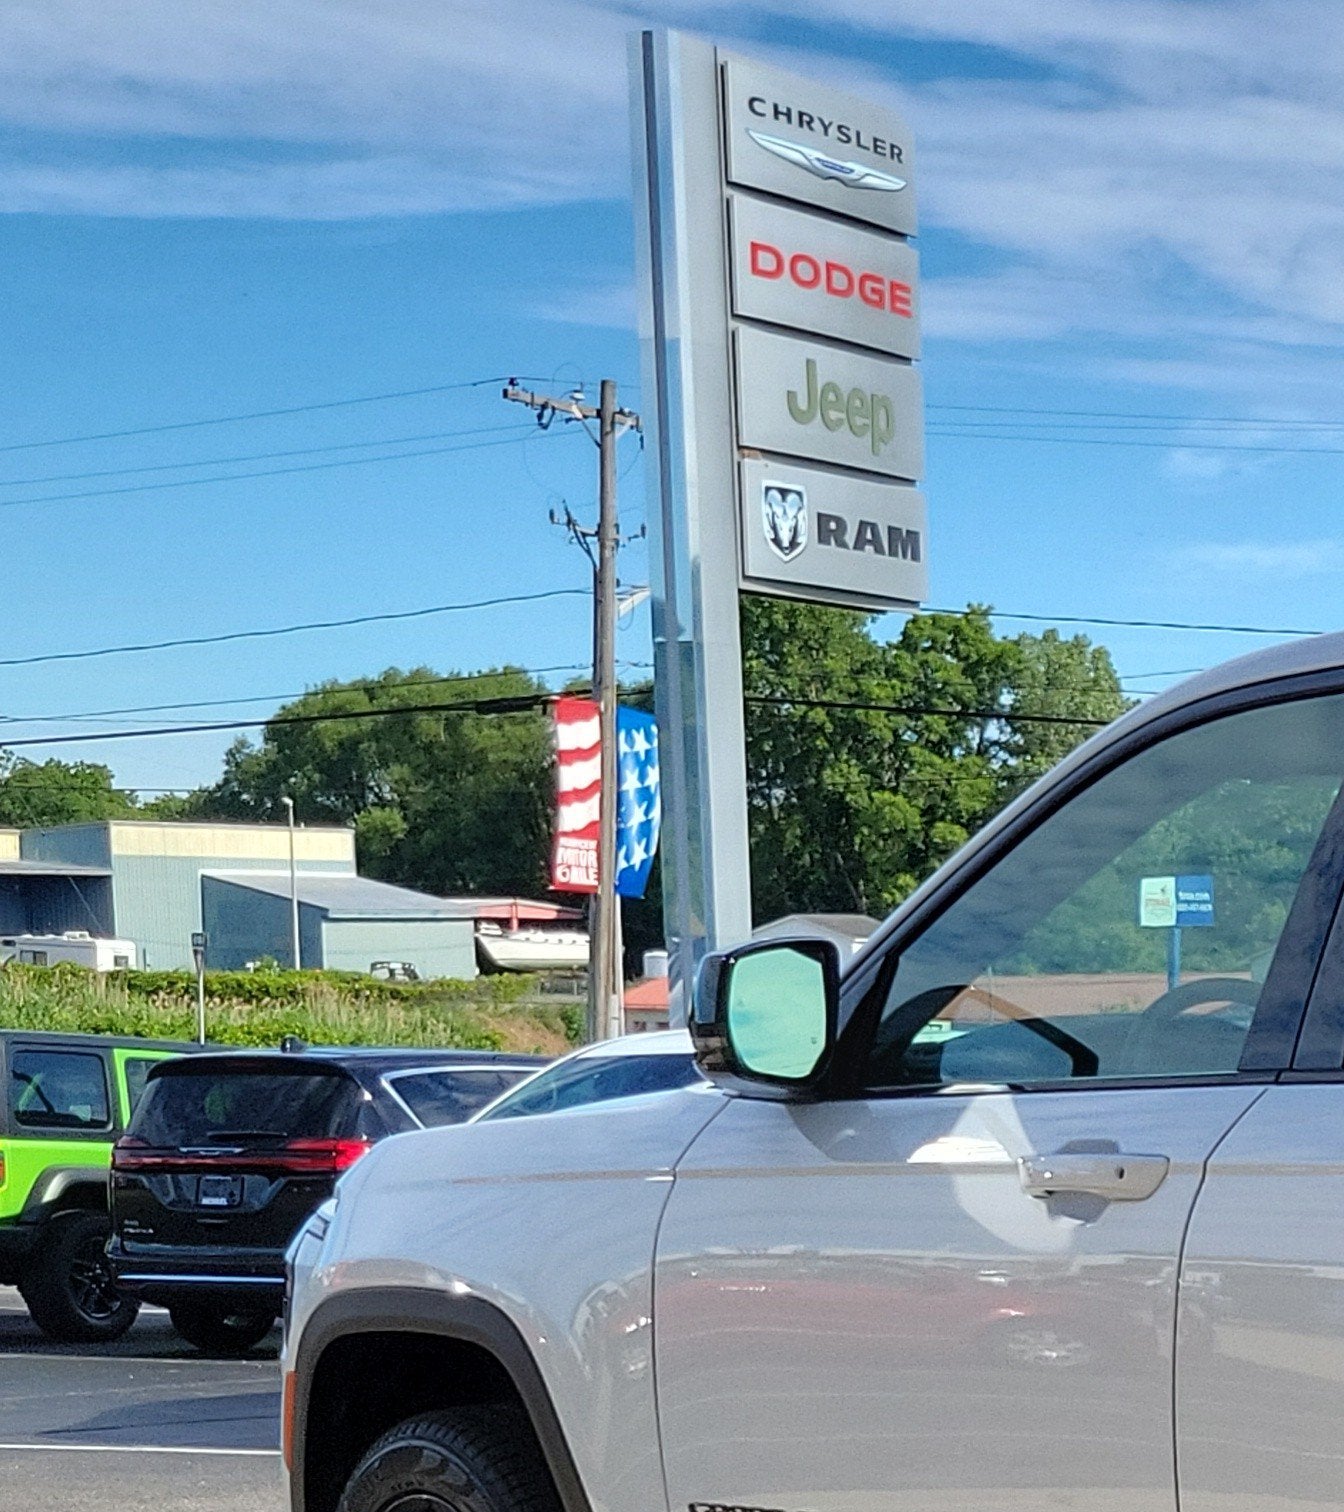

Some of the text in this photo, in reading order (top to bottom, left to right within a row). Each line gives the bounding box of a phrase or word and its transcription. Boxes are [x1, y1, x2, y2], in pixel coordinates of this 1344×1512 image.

[748, 96, 904, 164] CHRYSLER
[749, 240, 913, 319] DODGE
[786, 357, 895, 456] Jeep
[816, 511, 921, 563] RAM
